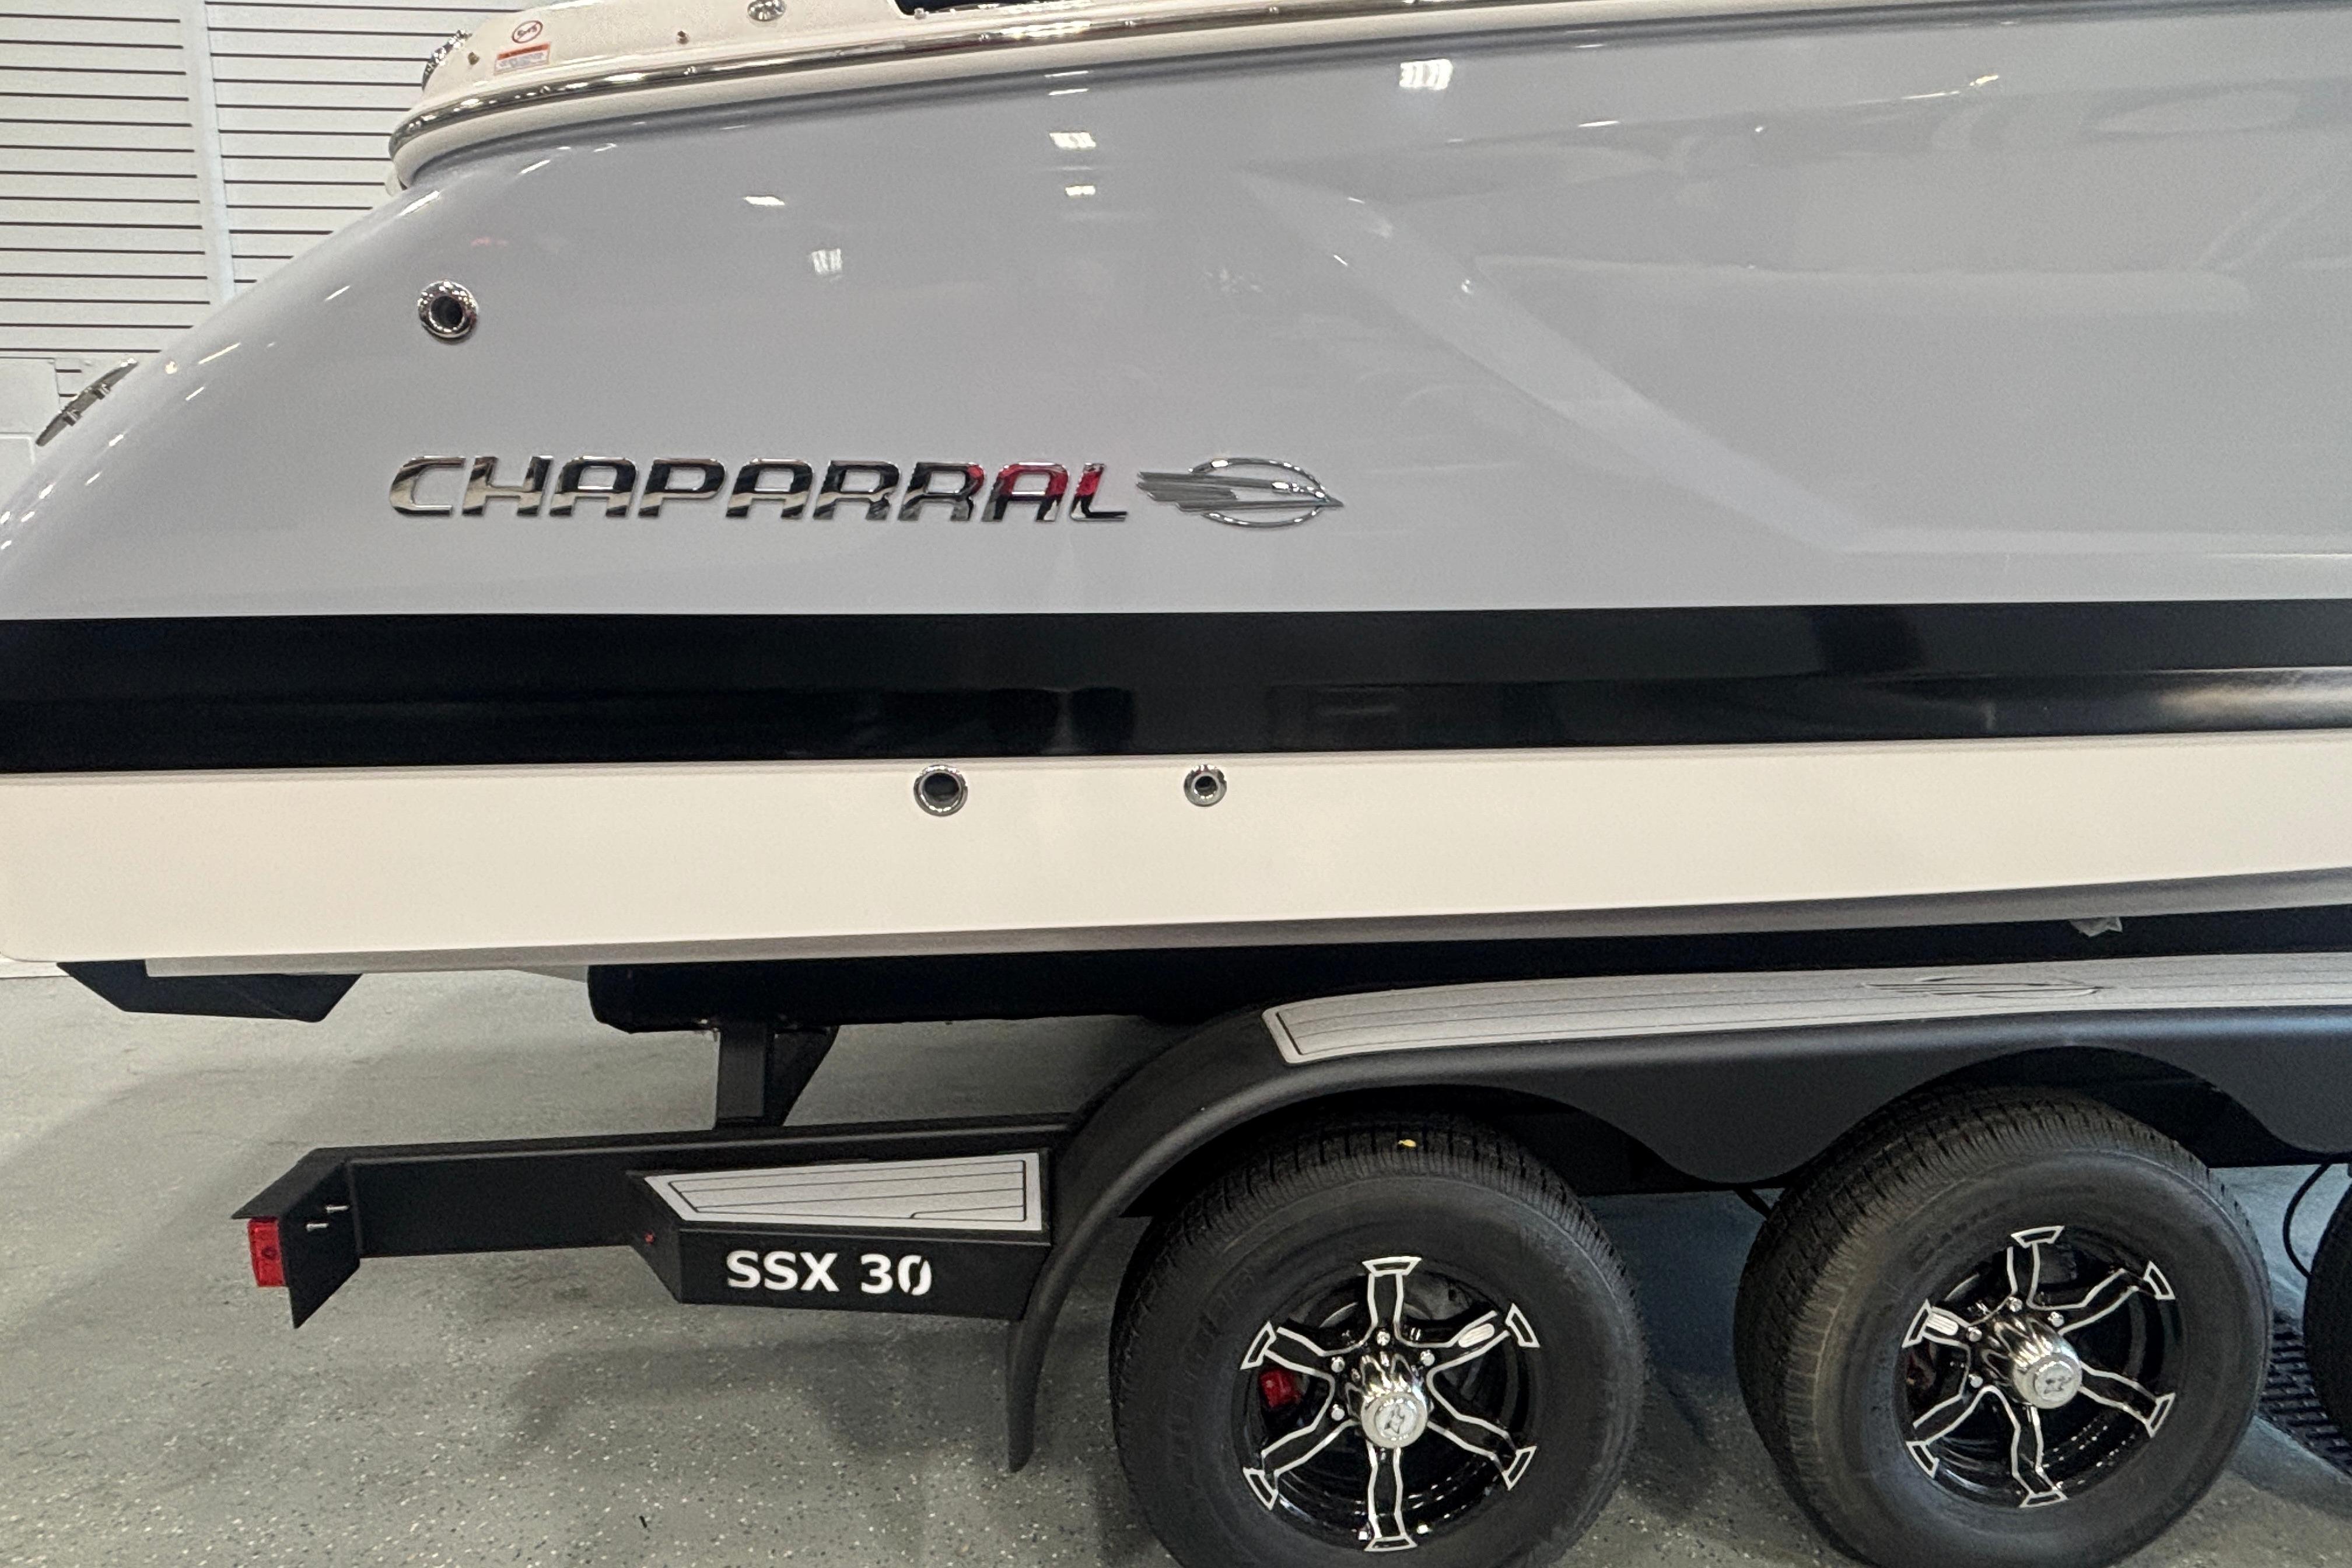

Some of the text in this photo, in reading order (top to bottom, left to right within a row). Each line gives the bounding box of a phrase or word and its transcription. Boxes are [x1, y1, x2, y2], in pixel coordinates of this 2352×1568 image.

[390, 454, 1128, 523] CHAPARRAL
[726, 1250, 933, 1296] SSX 30
